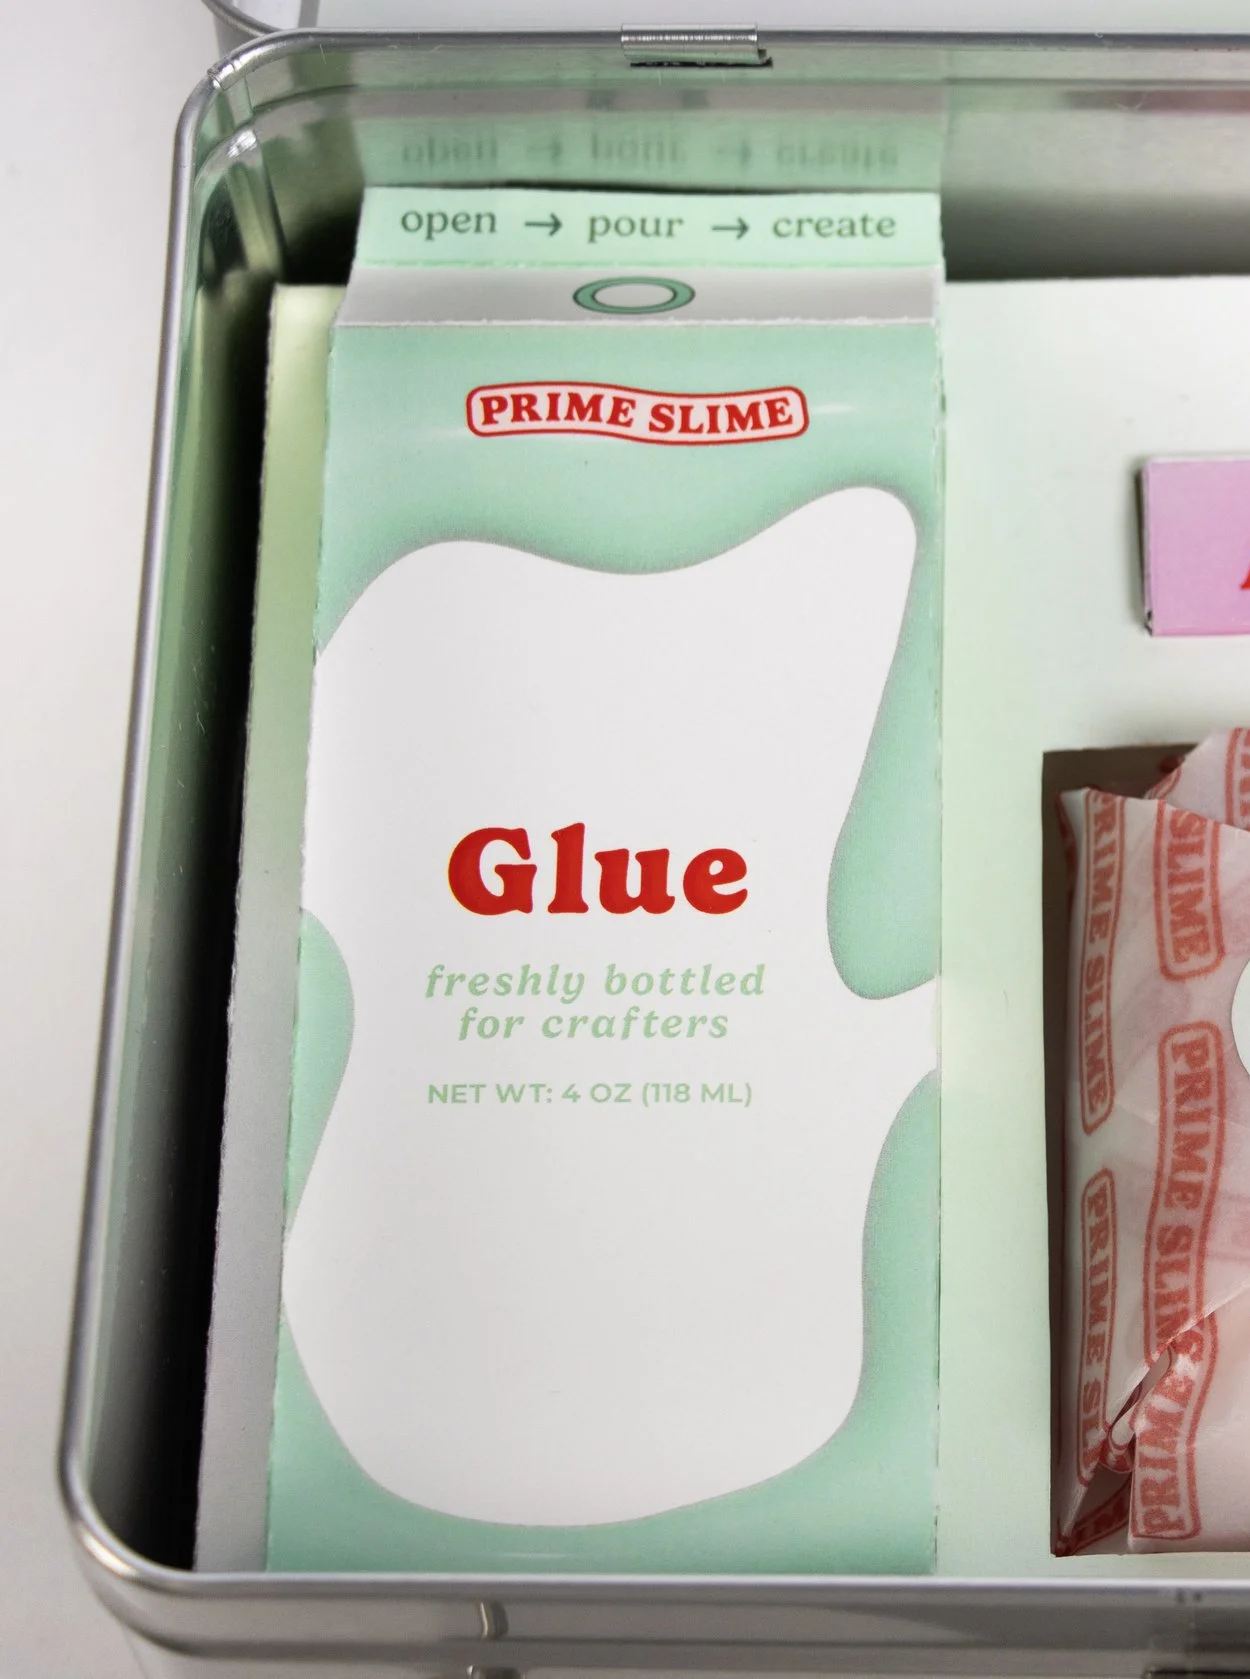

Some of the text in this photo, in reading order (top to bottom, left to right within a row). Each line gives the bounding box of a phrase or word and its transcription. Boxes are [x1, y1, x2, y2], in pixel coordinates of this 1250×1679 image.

[400, 207, 897, 244] open pour create
[480, 392, 794, 435] PRIME SLIME
[447, 822, 749, 916] Glue
[425, 963, 766, 1006] freshly bottled
[458, 1006, 729, 1041] for crafters
[427, 1082, 753, 1107] NET WT: 4 OZ (118 ML)
[1165, 1036, 1212, 1210] PRIME
[1136, 1374, 1196, 1536] PRIME
